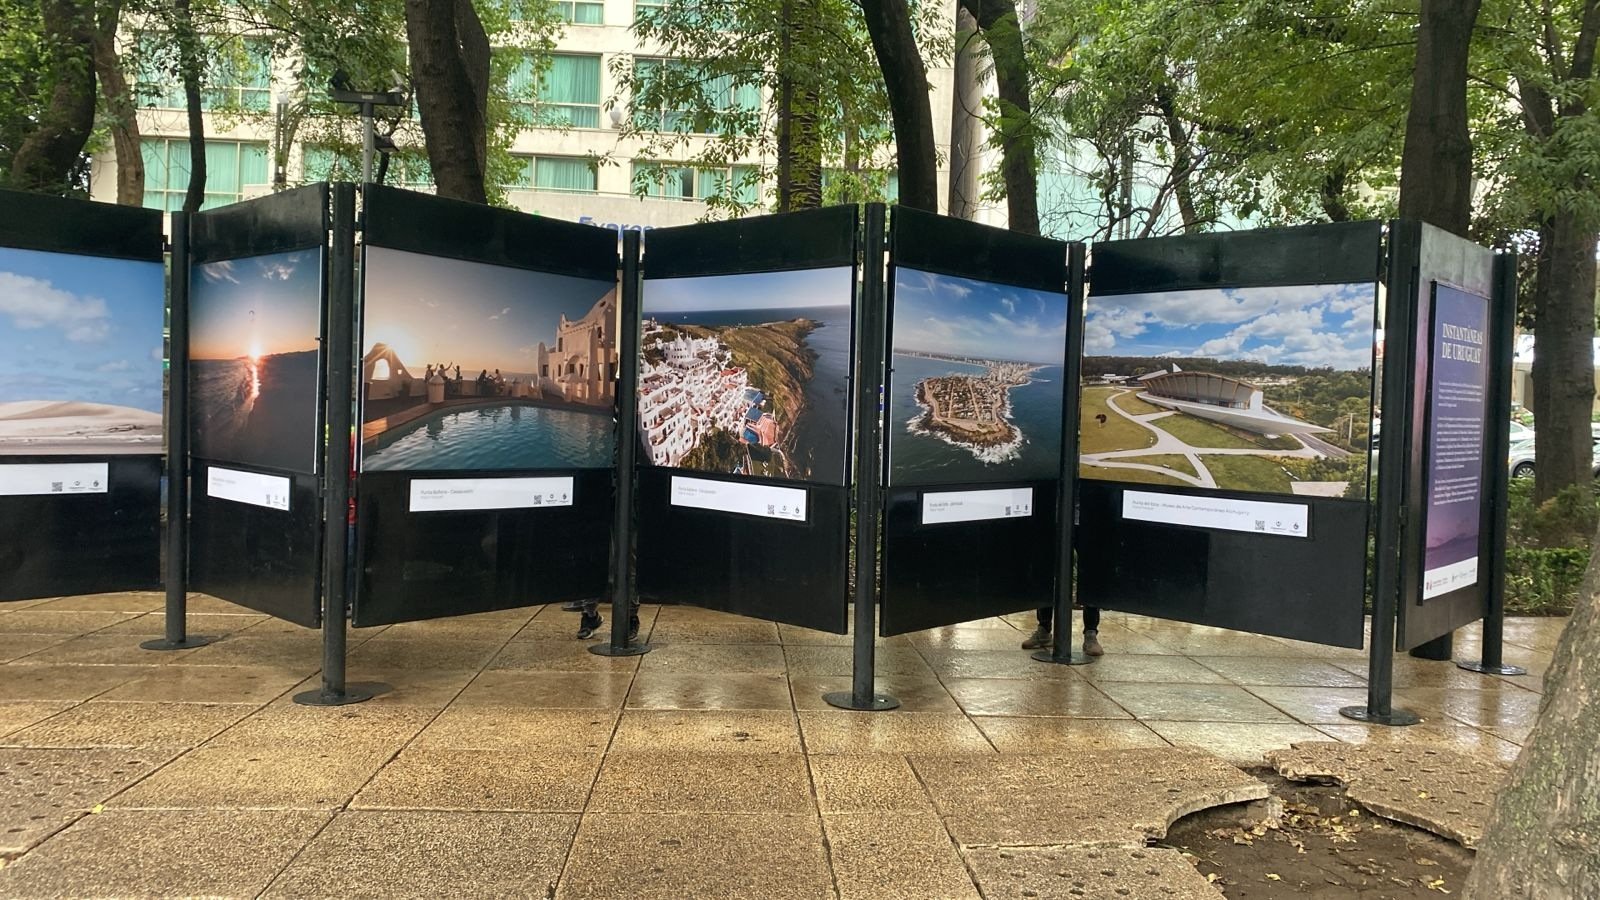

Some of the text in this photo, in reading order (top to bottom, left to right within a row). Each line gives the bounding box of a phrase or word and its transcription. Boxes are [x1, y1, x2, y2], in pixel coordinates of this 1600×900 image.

[1442, 323, 1483, 345] INSTANTÁNEAS
[1442, 342, 1482, 364] DE URUGUAY
